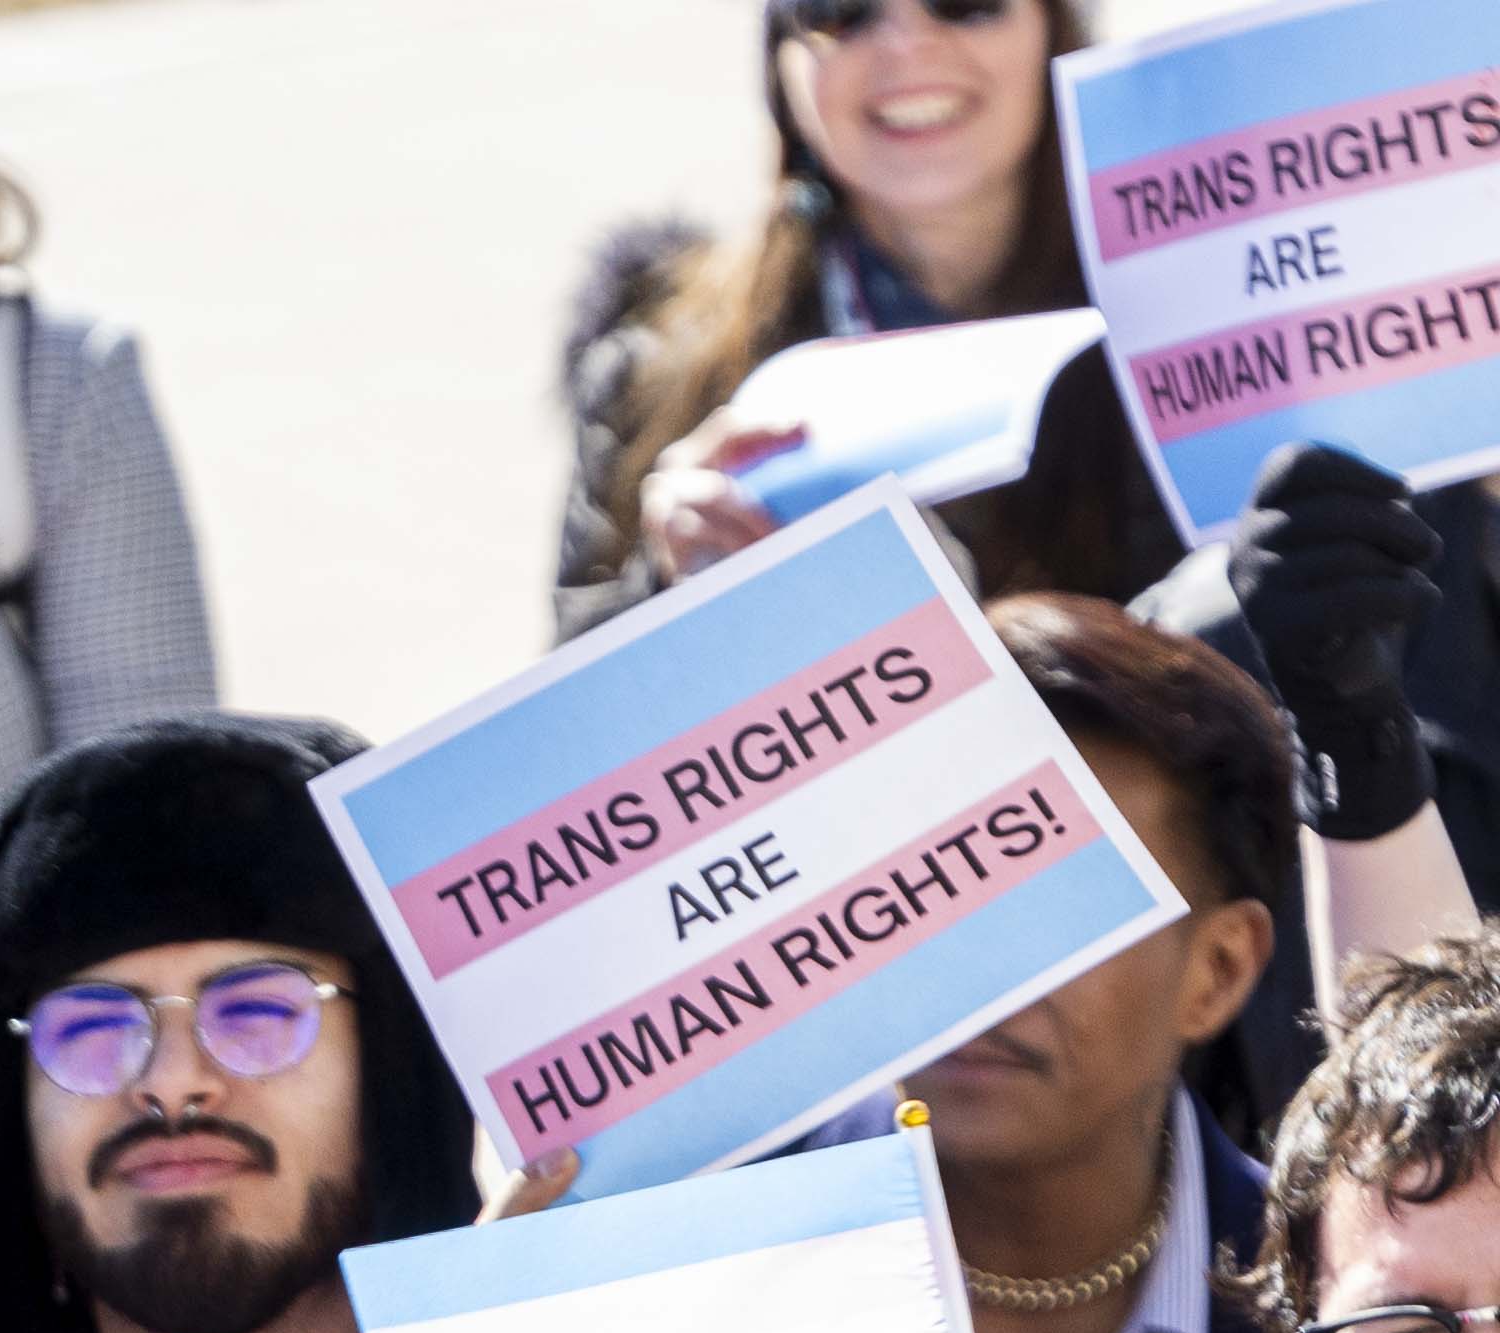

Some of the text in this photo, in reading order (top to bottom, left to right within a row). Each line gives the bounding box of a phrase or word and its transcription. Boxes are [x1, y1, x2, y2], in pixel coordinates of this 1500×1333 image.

[1114, 95, 1500, 238] TRANS RIGHTS
[1246, 226, 1344, 297] ARE
[1145, 331, 1290, 419] HUMAN
[438, 647, 933, 937] TRANS RIGHTS
[667, 832, 799, 941] ARE
[513, 787, 1066, 1134] HUMAN RIGHTS!
